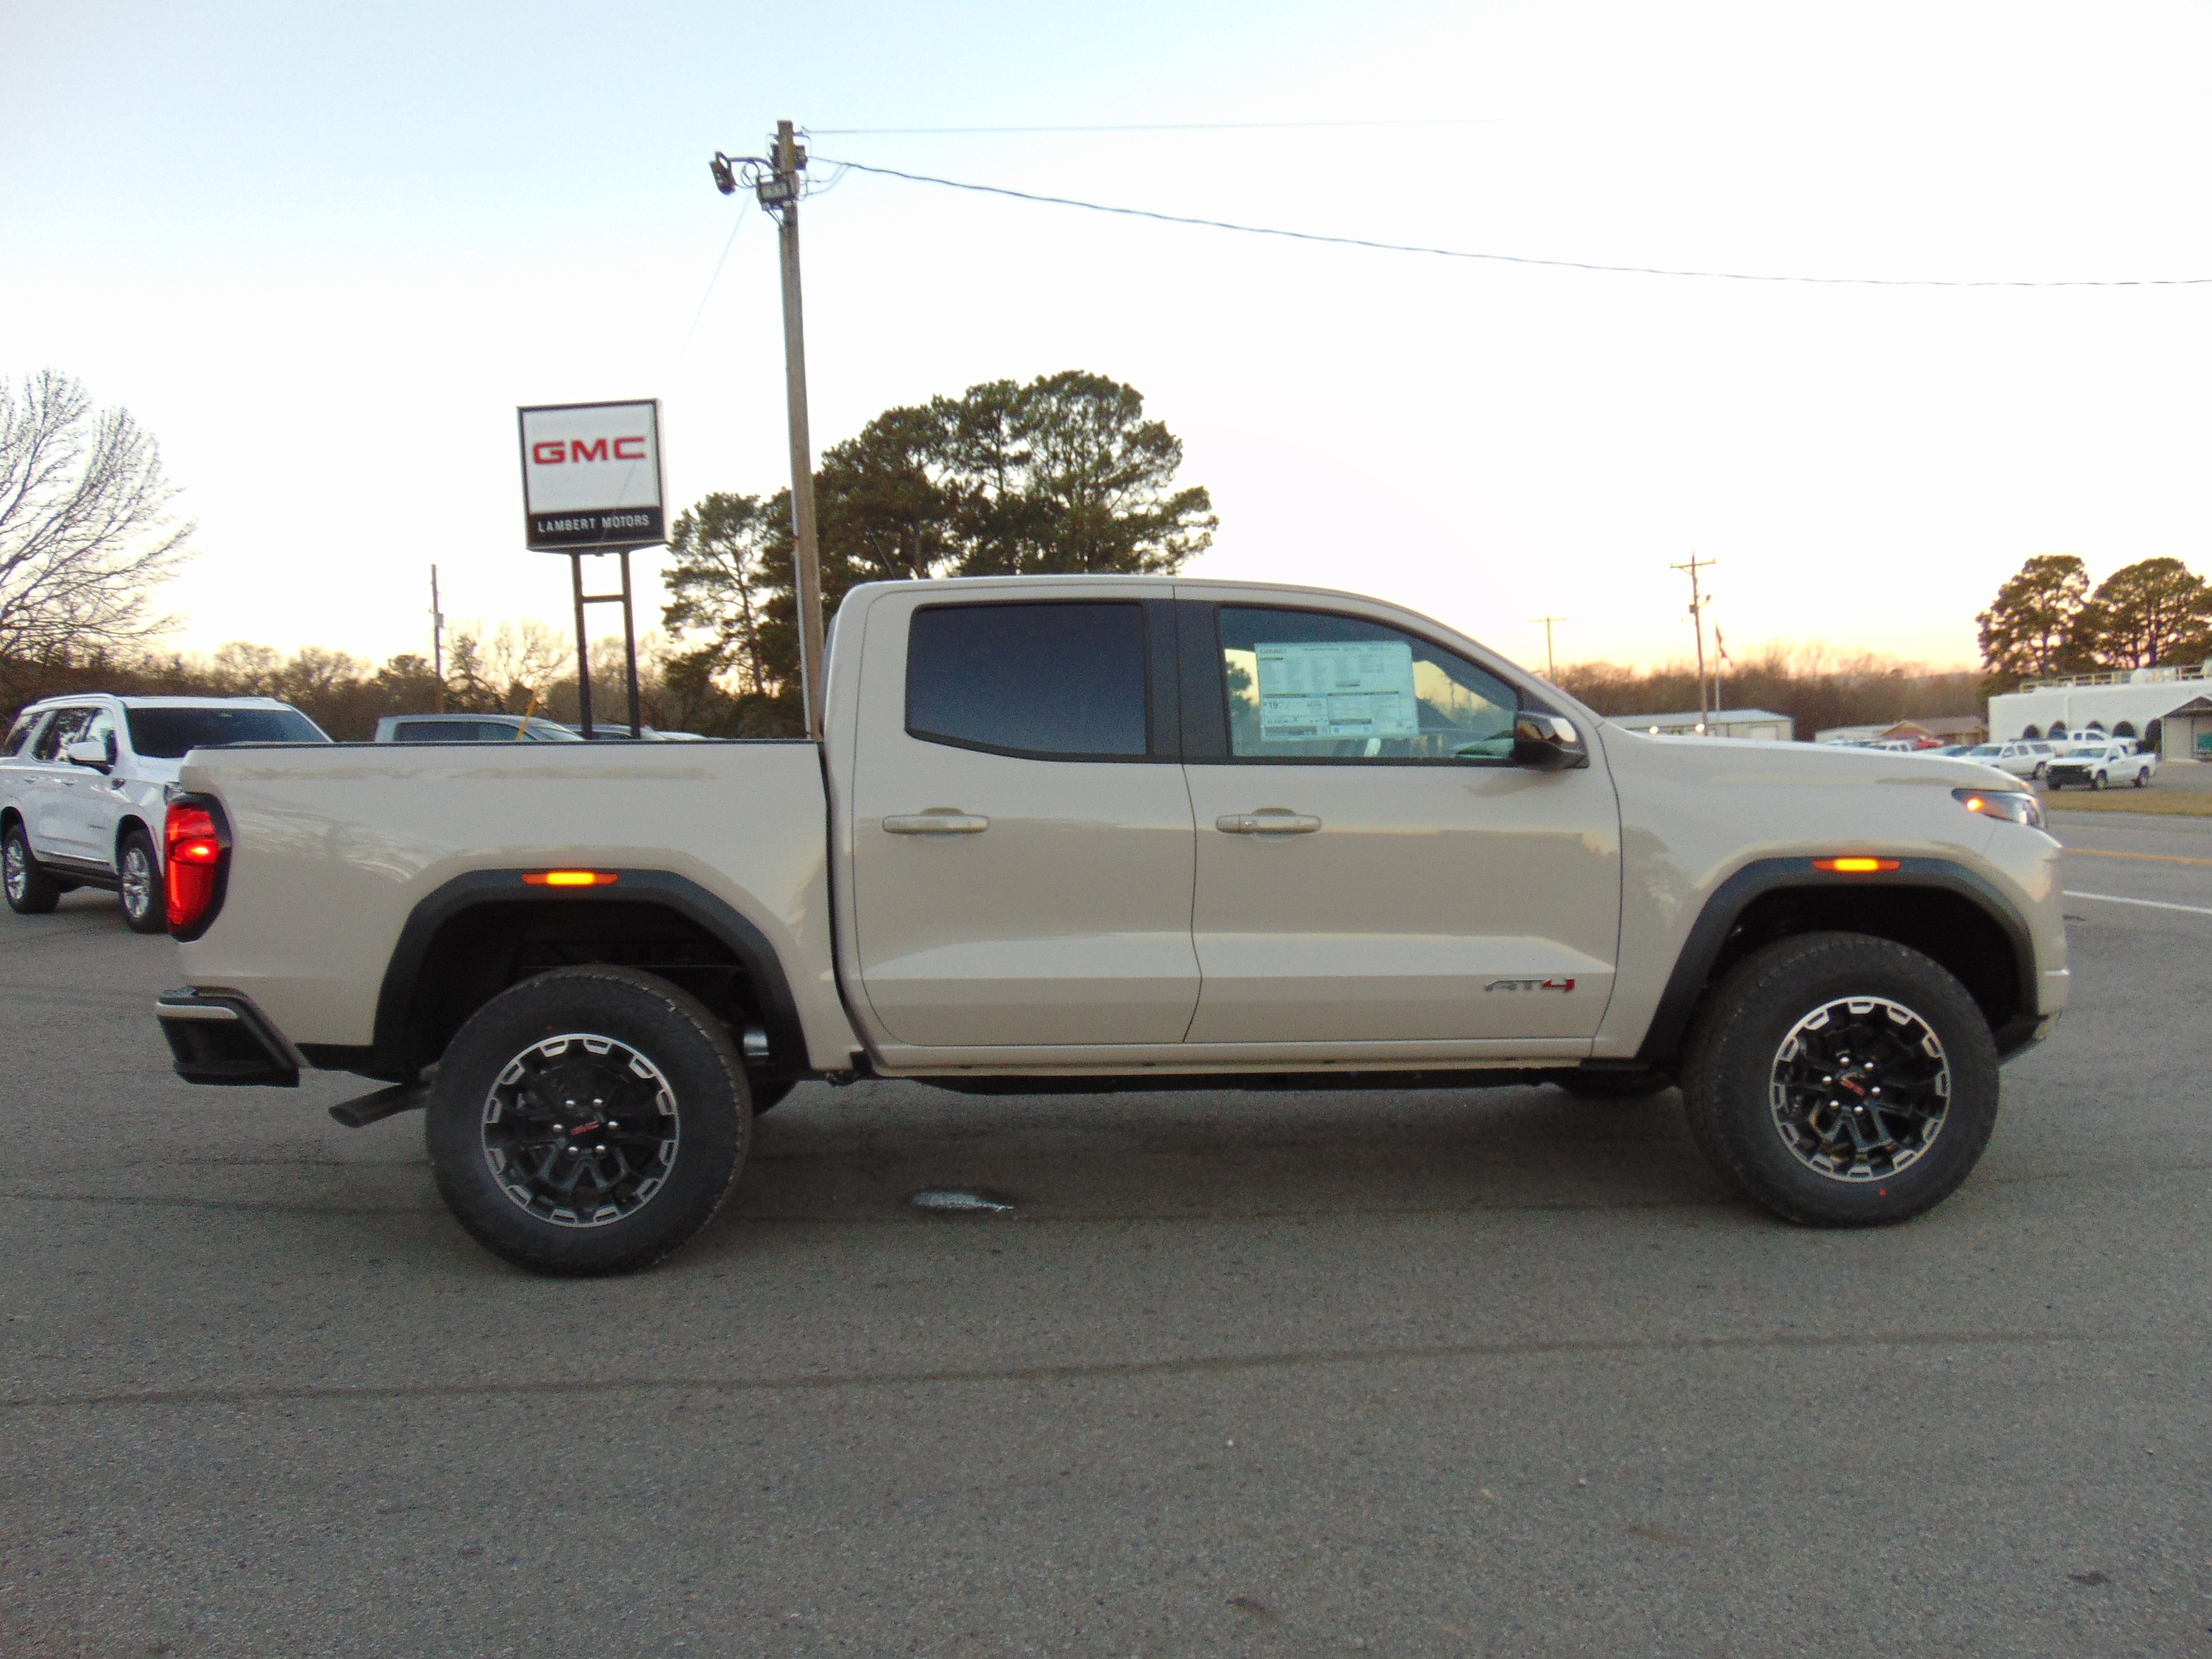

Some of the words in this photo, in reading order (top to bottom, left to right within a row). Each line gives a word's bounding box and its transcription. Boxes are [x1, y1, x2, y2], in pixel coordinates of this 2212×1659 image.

[533, 436, 646, 465] GMC
[538, 517, 596, 533] LAMBERT
[602, 514, 650, 529] MOTORS
[1484, 979, 1575, 995] AT4
